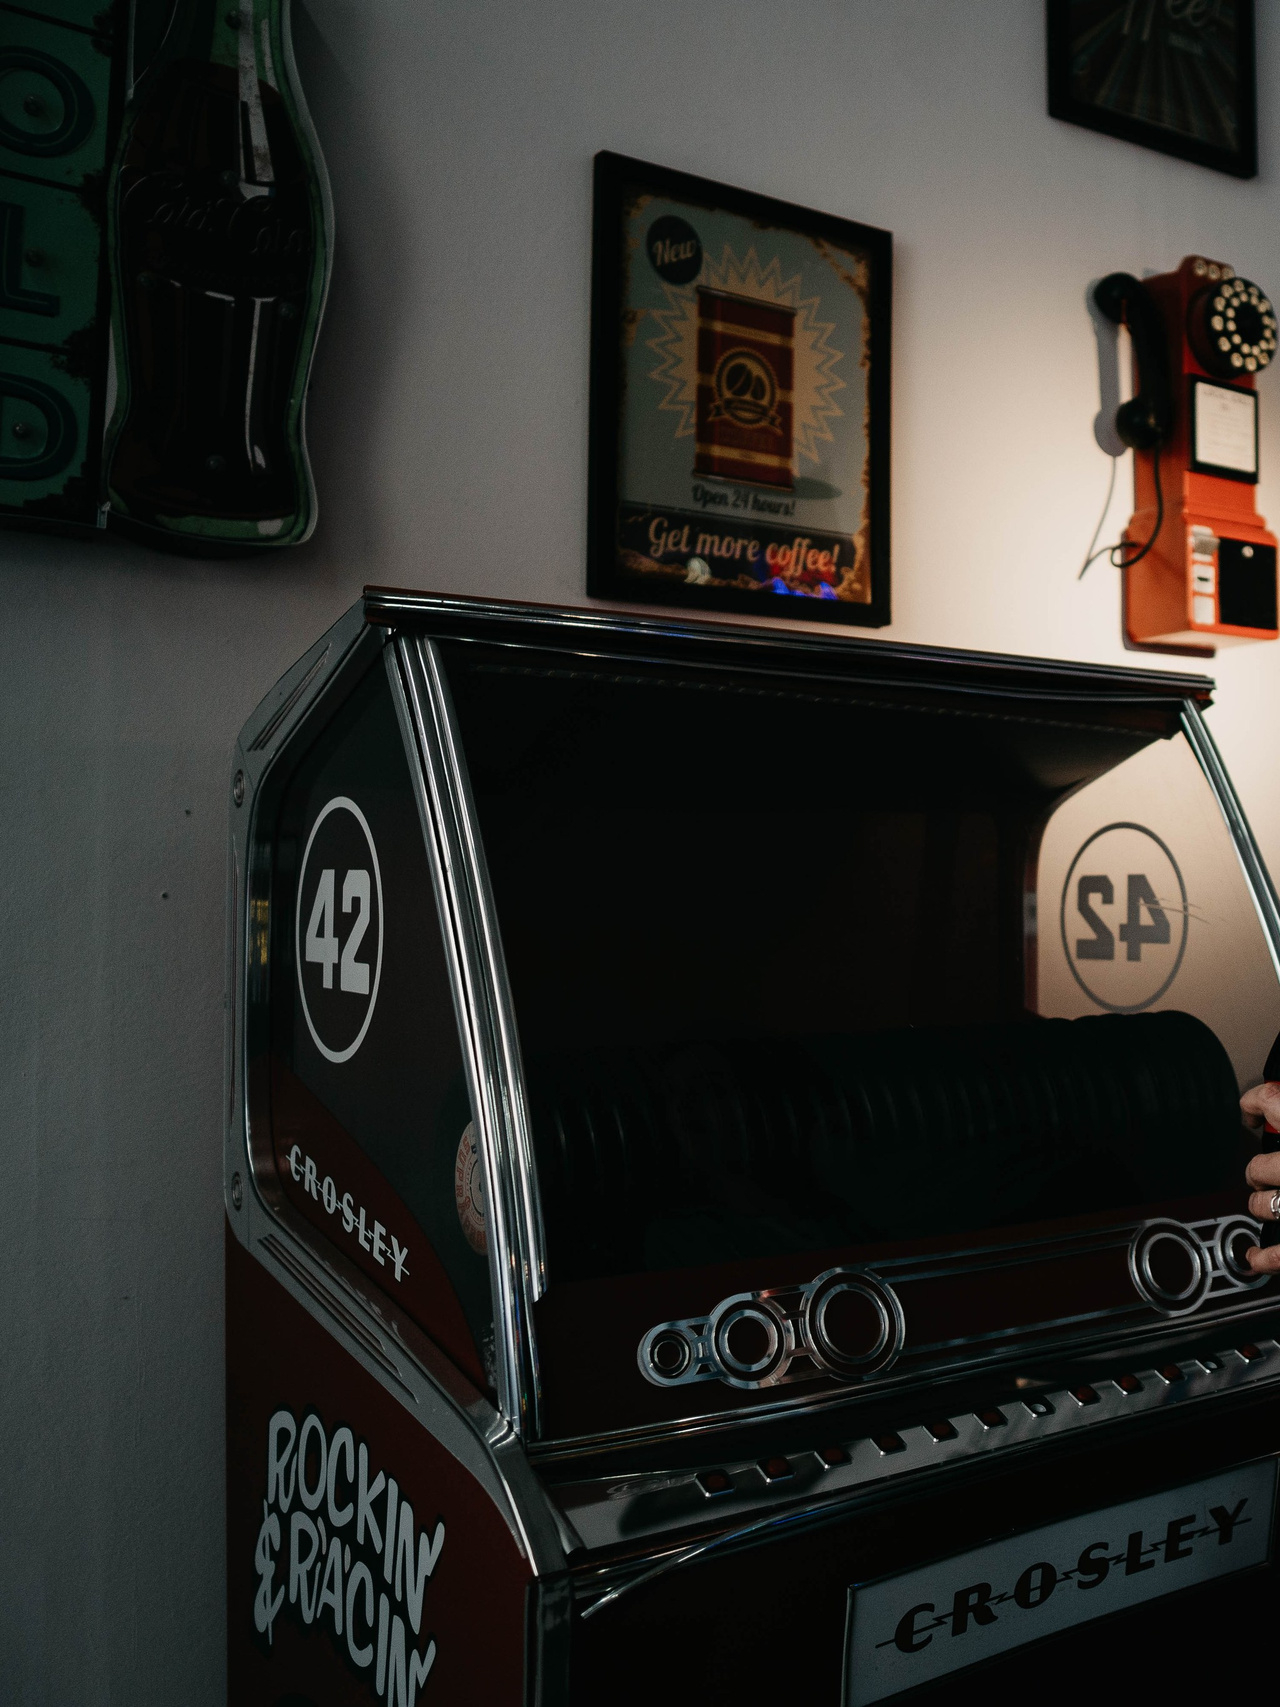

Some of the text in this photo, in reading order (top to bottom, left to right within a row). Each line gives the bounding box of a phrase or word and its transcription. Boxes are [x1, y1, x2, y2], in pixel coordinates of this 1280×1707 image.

[651, 237, 697, 267] New
[648, 516, 841, 577] Get more coffee!
[692, 484, 796, 517] Open 24 hours!
[305, 868, 371, 996] 42
[286, 1144, 411, 1283] CROSLEY
[253, 1498, 286, 1646] &
[880, 1498, 1252, 1654] CROSLEY
